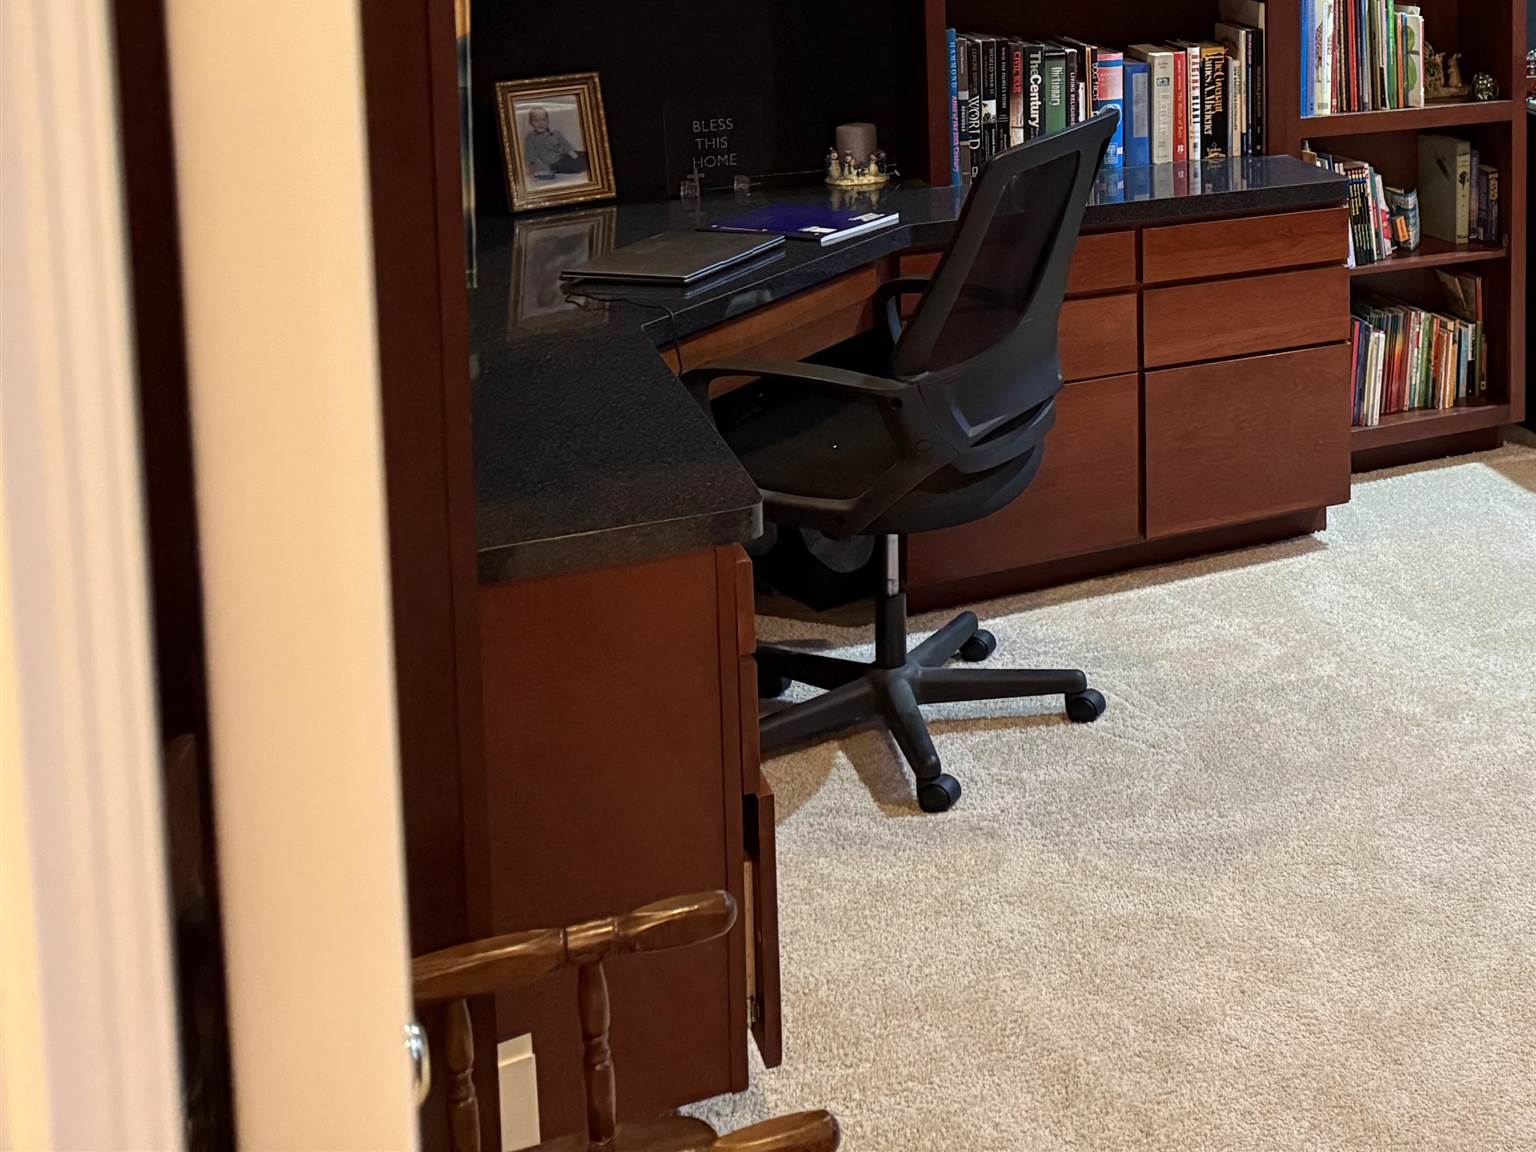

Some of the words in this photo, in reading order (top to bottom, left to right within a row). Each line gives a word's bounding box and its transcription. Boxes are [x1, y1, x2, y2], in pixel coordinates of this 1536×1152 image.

[1049, 66, 1063, 106] Dictionary
[1191, 54, 1199, 91] RAGING
[949, 41, 957, 89] HAMMOND
[953, 147, 961, 173] Century
[1192, 95, 1200, 125] HEART
[1214, 71, 1225, 113] Covenant
[692, 117, 734, 133] BLESS
[967, 95, 981, 150] WORLD
[1204, 95, 1216, 136] Michener
[692, 153, 737, 169] HOME
[695, 136, 728, 150] THIS
